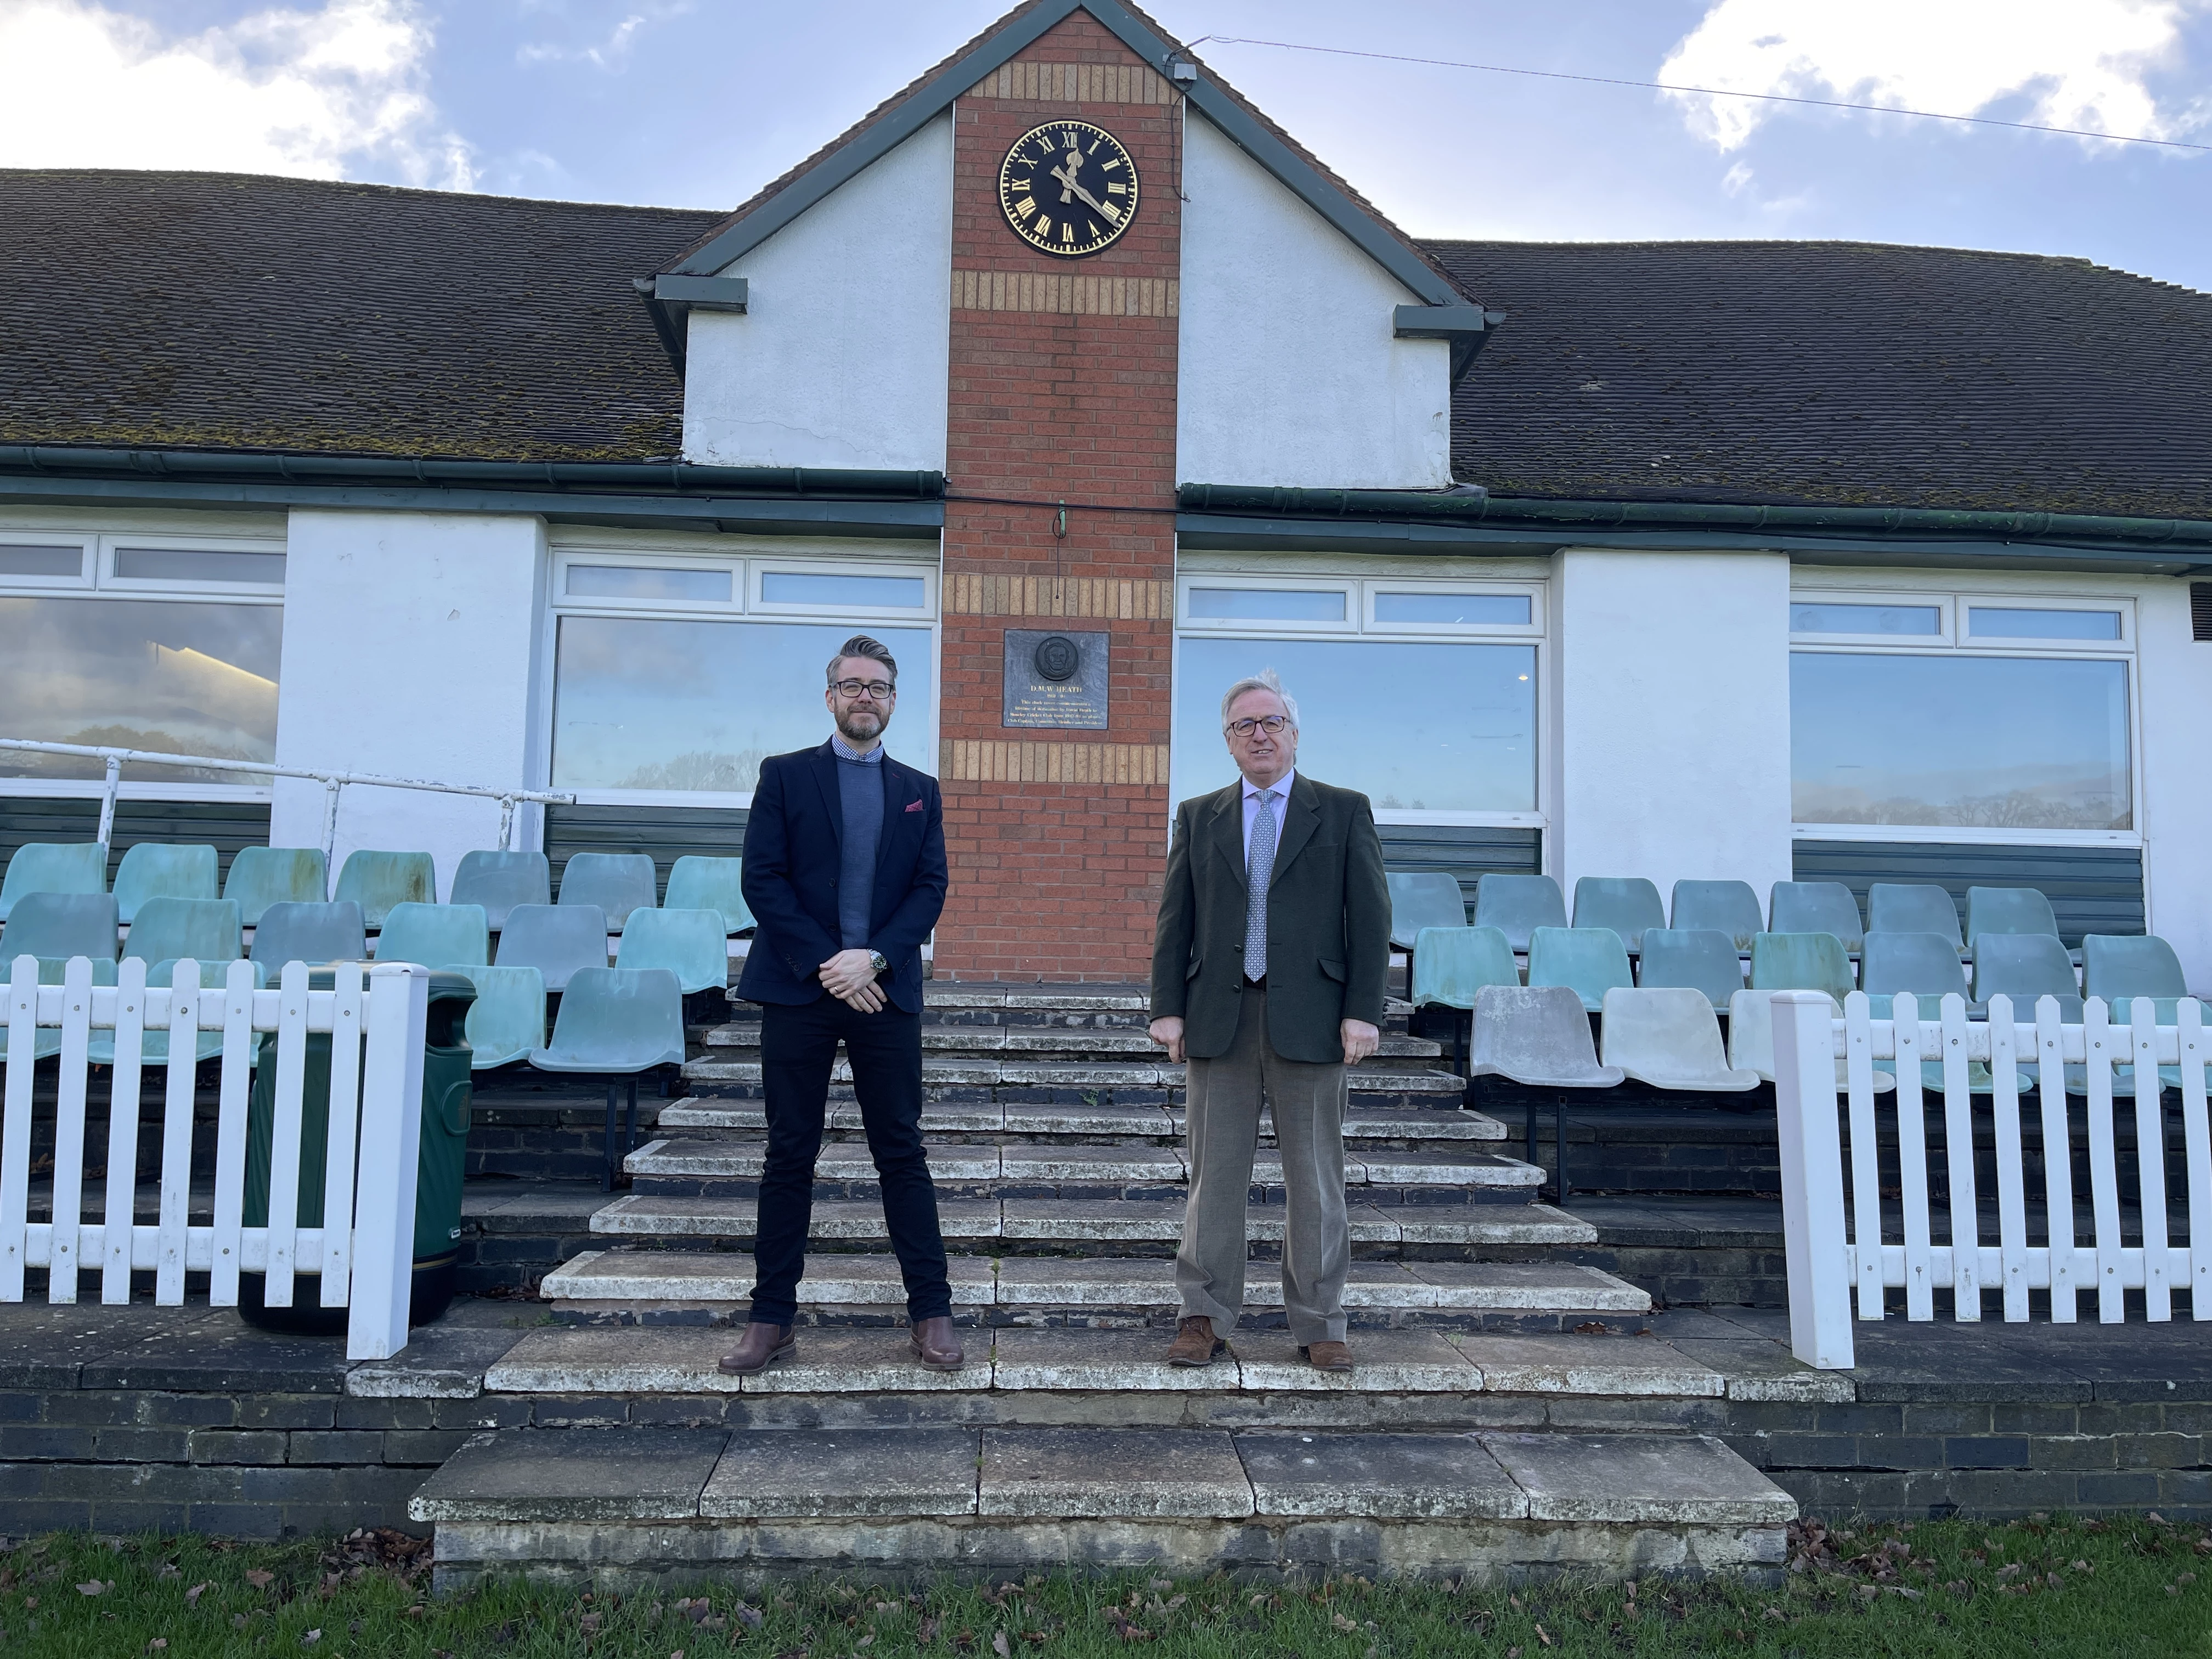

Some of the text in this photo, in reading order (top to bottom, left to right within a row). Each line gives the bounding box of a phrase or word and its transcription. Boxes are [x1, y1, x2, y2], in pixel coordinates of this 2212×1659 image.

[1036, 135, 1055, 155] XI
[1062, 131, 1078, 148] XII
[1087, 139, 1101, 155] I
[1018, 153, 1038, 170] X
[1101, 158, 1120, 172] II
[1012, 177, 1030, 191] IX
[1108, 182, 1126, 195] III
[1015, 195, 1036, 220] VIII
[1034, 213, 1052, 237] VII
[1062, 222, 1074, 242] VI
[1087, 219, 1100, 238] V
